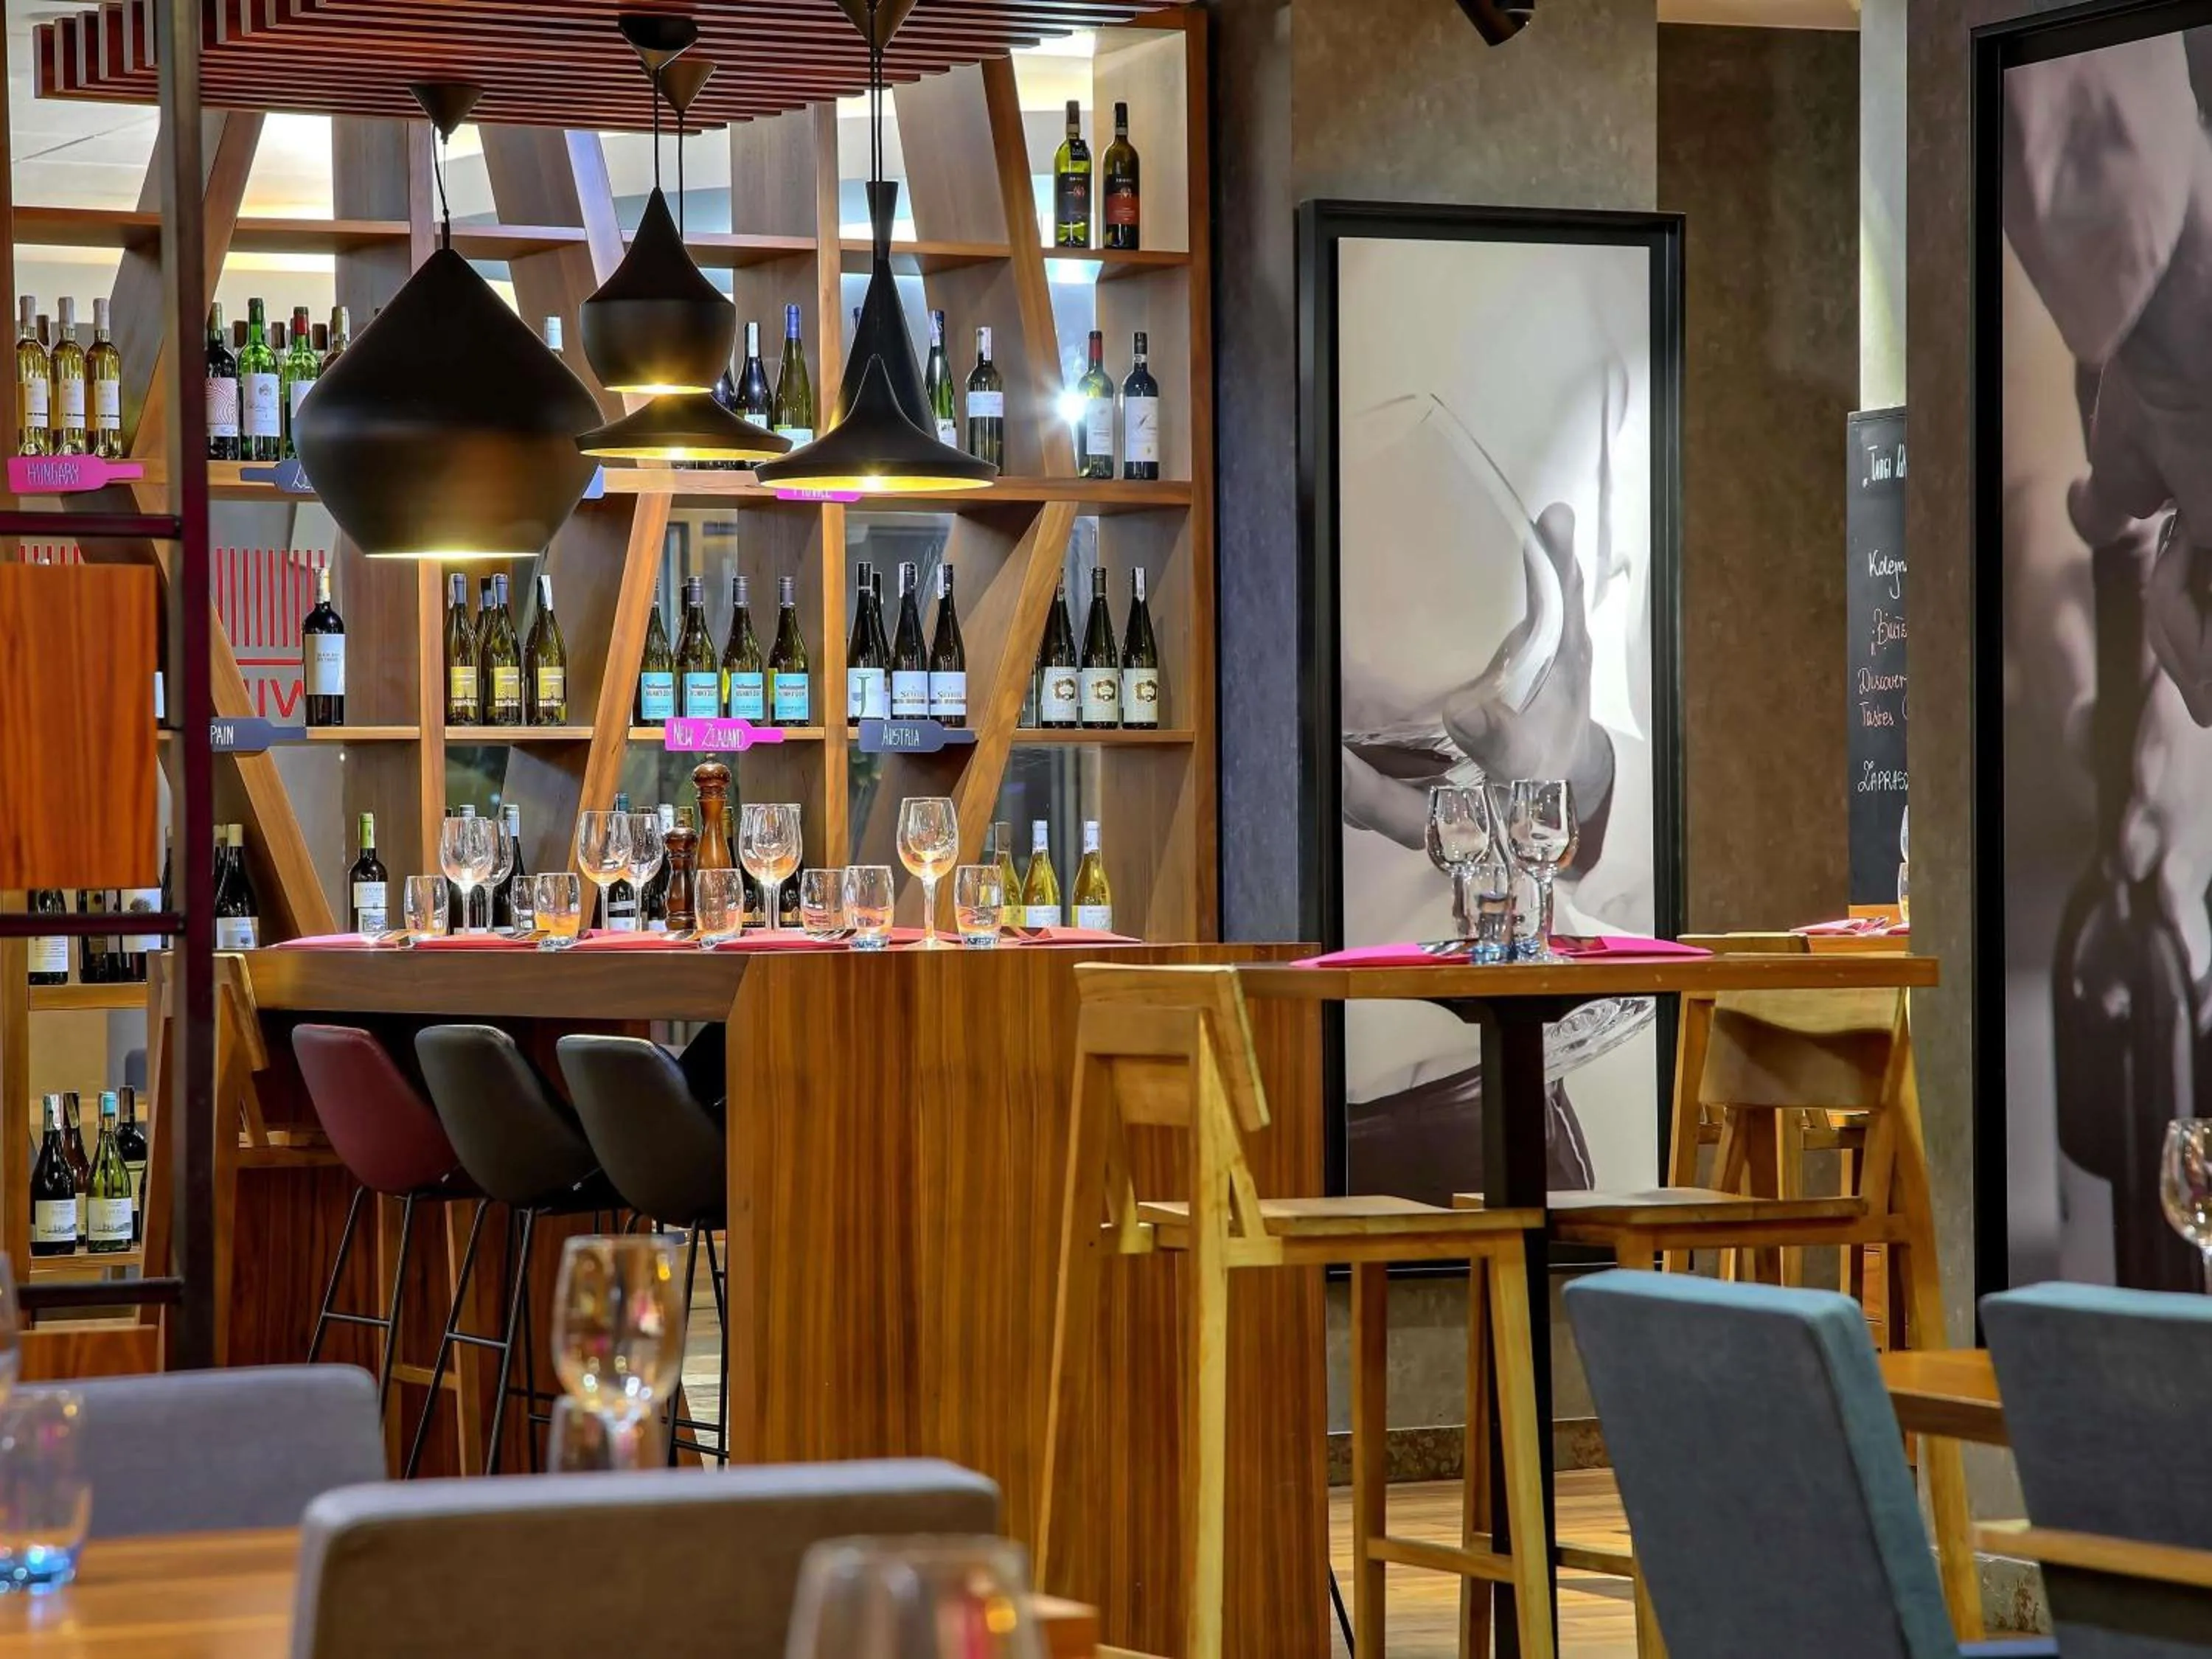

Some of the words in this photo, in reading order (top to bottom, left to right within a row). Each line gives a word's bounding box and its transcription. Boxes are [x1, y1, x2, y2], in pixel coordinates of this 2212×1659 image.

[27, 462, 80, 485] HUNGARY
[209, 725, 234, 745] PAIN
[882, 724, 920, 747] AUSTRIA
